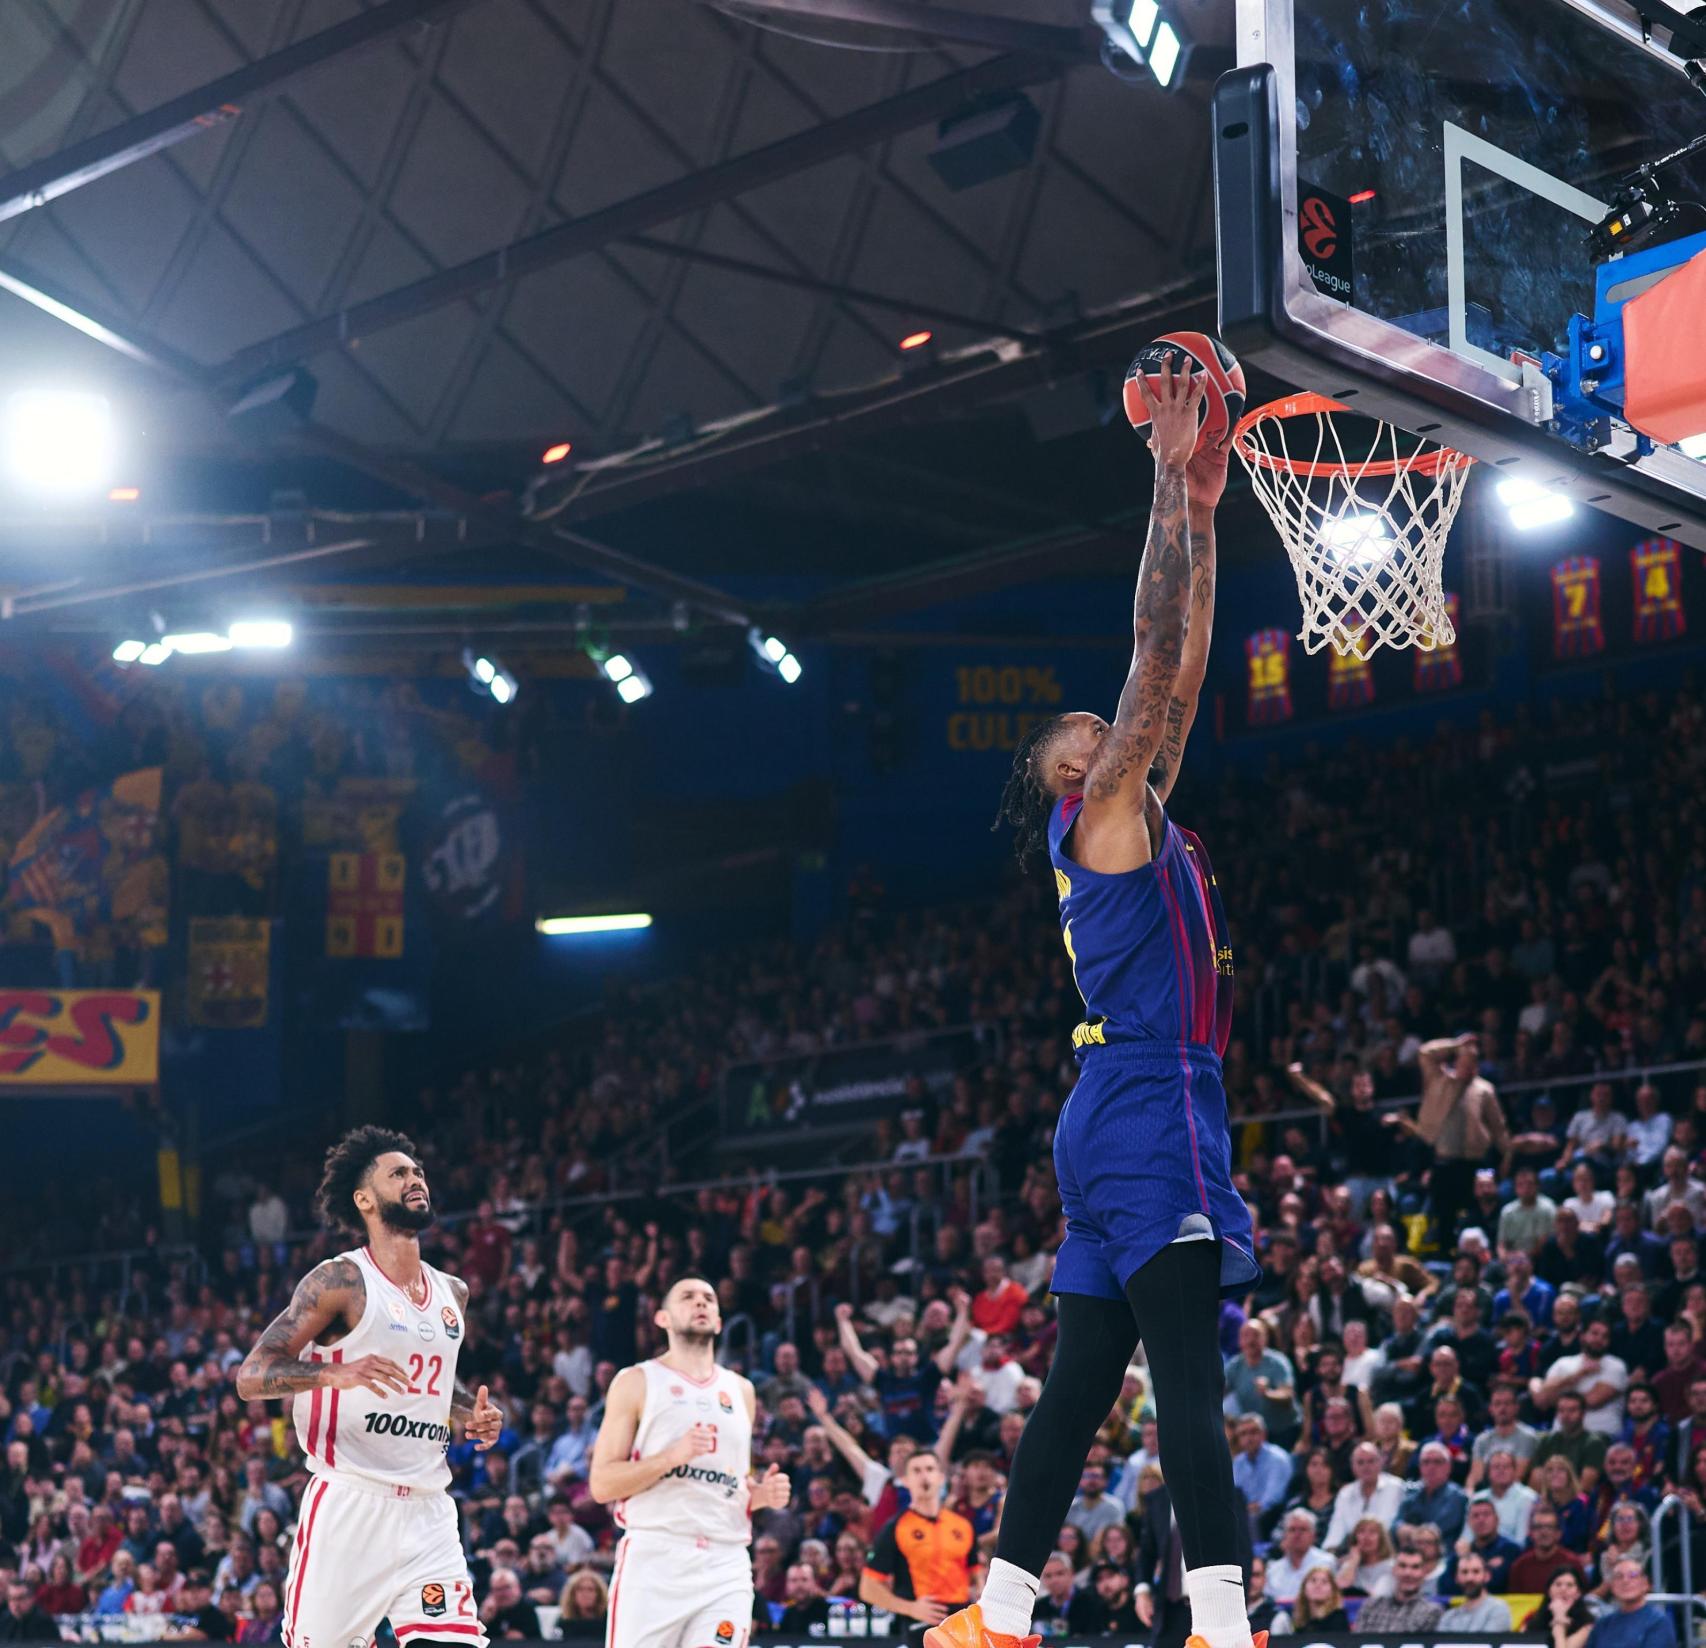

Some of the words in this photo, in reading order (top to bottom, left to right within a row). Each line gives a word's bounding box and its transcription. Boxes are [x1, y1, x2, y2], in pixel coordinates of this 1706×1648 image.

[1564, 584, 1587, 617] 7
[956, 666, 1062, 704] 100%
[407, 1353, 443, 1396] 22
[454, 1582, 473, 1616] 2
